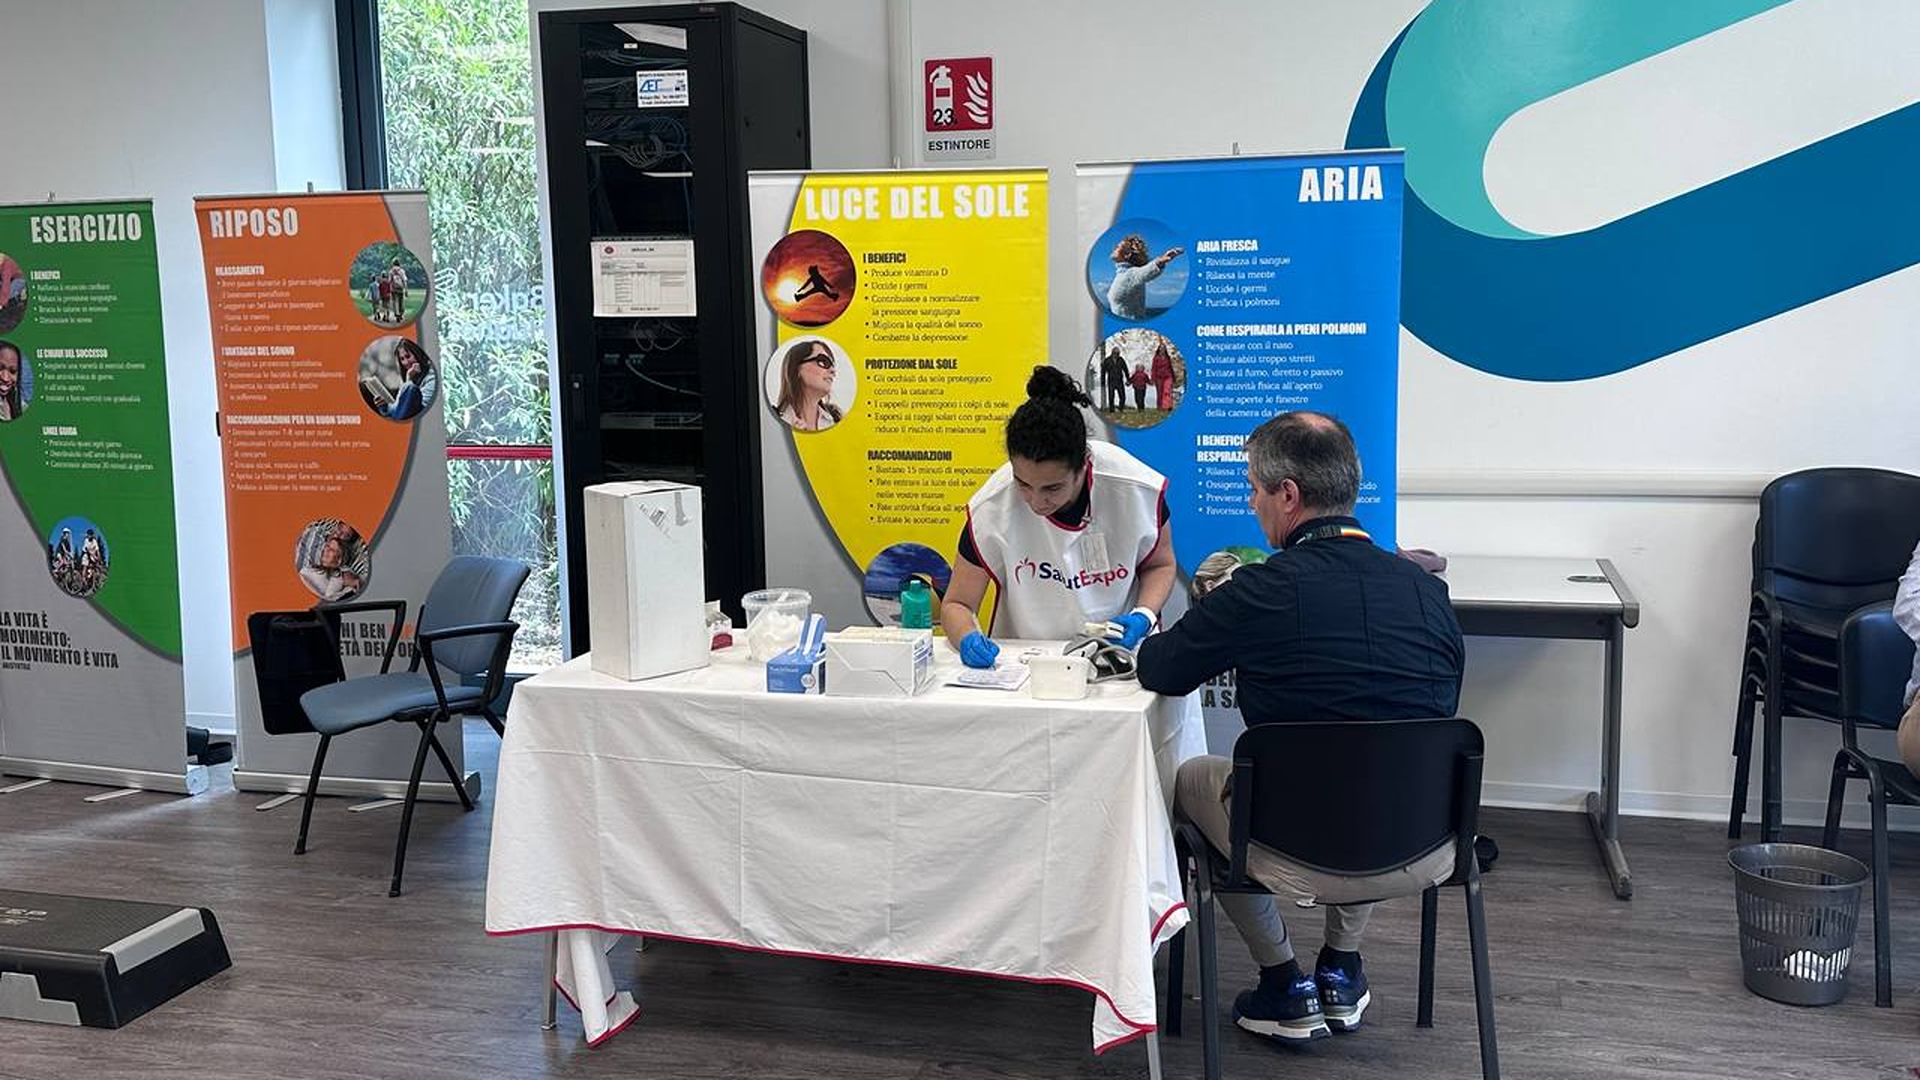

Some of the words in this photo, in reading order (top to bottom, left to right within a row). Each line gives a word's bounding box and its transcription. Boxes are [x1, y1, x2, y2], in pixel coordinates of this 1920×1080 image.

[928, 139, 990, 151] ESTINTORE
[1298, 166, 1384, 203] ARIA
[805, 187, 881, 221] LUCE
[889, 185, 944, 219] DEL
[953, 183, 1030, 219] SOLE
[30, 212, 143, 244] ESERCIZIO
[209, 207, 299, 238] RIPOSO
[1196, 240, 1221, 253] ARIA
[1221, 239, 1258, 252] FRESCA
[868, 252, 907, 264] BENEFICI
[1205, 257, 1249, 266] Rivitalizza
[1252, 257, 1258, 265] il
[1259, 257, 1291, 267] sangue
[871, 268, 901, 277] Produce
[904, 268, 940, 276] vitamina
[941, 268, 949, 276] D
[1205, 271, 1235, 280] Rilassa
[1237, 271, 1246, 279] la
[1247, 271, 1276, 279] mente
[871, 281, 897, 290] Uccide
[904, 281, 928, 292] germi
[1205, 285, 1235, 294] Uccide
[1242, 285, 1268, 295] germi
[871, 294, 920, 303] Contribuisce
[929, 294, 980, 302] normalizzare
[1205, 298, 1238, 308] Purifica
[1245, 298, 1280, 309] polmoni
[872, 307, 879, 316] la
[880, 307, 918, 318] pressione
[919, 307, 961, 318] sanguigna
[872, 320, 905, 331] Migliora
[906, 320, 913, 328] la
[915, 320, 943, 331] qualità
[944, 320, 956, 329] del
[1196, 325, 1225, 337] COME
[1226, 324, 1285, 337] RESPIRARLA
[1285, 324, 1293, 336] A
[1294, 323, 1321, 336] PIENI
[1322, 322, 1367, 335] POLMONI
[872, 333, 911, 342] Combatte
[912, 333, 920, 342] la
[921, 333, 969, 344] depressione
[1205, 342, 1245, 352] Respirate
[1265, 342, 1271, 350] il
[865, 358, 917, 370] PROTEZIONE
[918, 358, 935, 370] DAL
[936, 358, 958, 370] SOLE
[1205, 355, 1235, 363] Evitate
[1237, 355, 1257, 363] abiti
[1258, 356, 1287, 365] troppo
[1289, 355, 1315, 363] stretti
[1205, 369, 1235, 377] Evitate
[1272, 368, 1301, 377] diretto
[1310, 368, 1344, 379] passivo
[873, 374, 885, 383] Gli
[886, 374, 917, 383] occhiali
[918, 374, 928, 382] da
[929, 374, 946, 382] sole
[947, 375, 992, 385] proteggono
[874, 388, 899, 396] contro
[901, 387, 909, 395] la
[1205, 382, 1223, 390] Fate
[1225, 381, 1256, 390] attività
[1257, 381, 1280, 390] fisica
[1281, 381, 1323, 392] all'aperto
[879, 400, 909, 410] cappelli
[910, 401, 958, 411] prevengono
[963, 400, 982, 410] colpi
[984, 400, 992, 409] di
[993, 400, 1009, 409] sole
[1205, 395, 1234, 404] Tenete
[1236, 396, 1263, 405] aperte
[1265, 395, 1274, 403] le
[1275, 395, 1308, 403] finestre
[874, 413, 902, 422] Esporsi
[904, 413, 911, 421] ai
[913, 413, 934, 423] raggi
[935, 413, 957, 421] solari
[1205, 409, 1226, 417] della
[1228, 409, 1259, 417] camera
[1260, 408, 1272, 417] da
[875, 425, 900, 434] riduce
[908, 425, 934, 434] rischio
[935, 425, 944, 433] di
[945, 426, 987, 434] melanoma
[1202, 434, 1244, 447] BENEFICI
[867, 450, 952, 461] RACCOMANDAZIONI
[875, 465, 905, 474] Bastano
[907, 465, 916, 474] 15
[917, 465, 944, 474] minuti
[945, 466, 953, 474] di
[1205, 467, 1235, 476] Rilassa
[876, 479, 892, 487] Fate
[893, 479, 921, 487] entrare
[922, 479, 930, 487] la
[931, 479, 946, 487] luce
[947, 479, 960, 487] del
[961, 479, 977, 487] sole
[1205, 481, 1243, 491] Ossigena
[876, 491, 895, 499] nelle
[896, 491, 919, 499] vostre
[1205, 493, 1243, 502] Previene
[876, 503, 892, 512] Fate
[893, 503, 920, 512] attività
[921, 503, 941, 512] fisica
[1206, 506, 1246, 516] Favorisce
[877, 515, 902, 524] Evitate
[904, 516, 912, 524] le
[913, 516, 950, 525] scottature
[0, 611, 11, 628] LA
[13, 611, 39, 629] VITA
[42, 610, 48, 629] È
[360, 623, 386, 640] BEN
[0, 628, 72, 649] MOVIMENTO:
[1, 646, 12, 661] IL
[14, 646, 81, 666] MOVIMENTO
[84, 648, 91, 667] È
[92, 651, 120, 669] VITA
